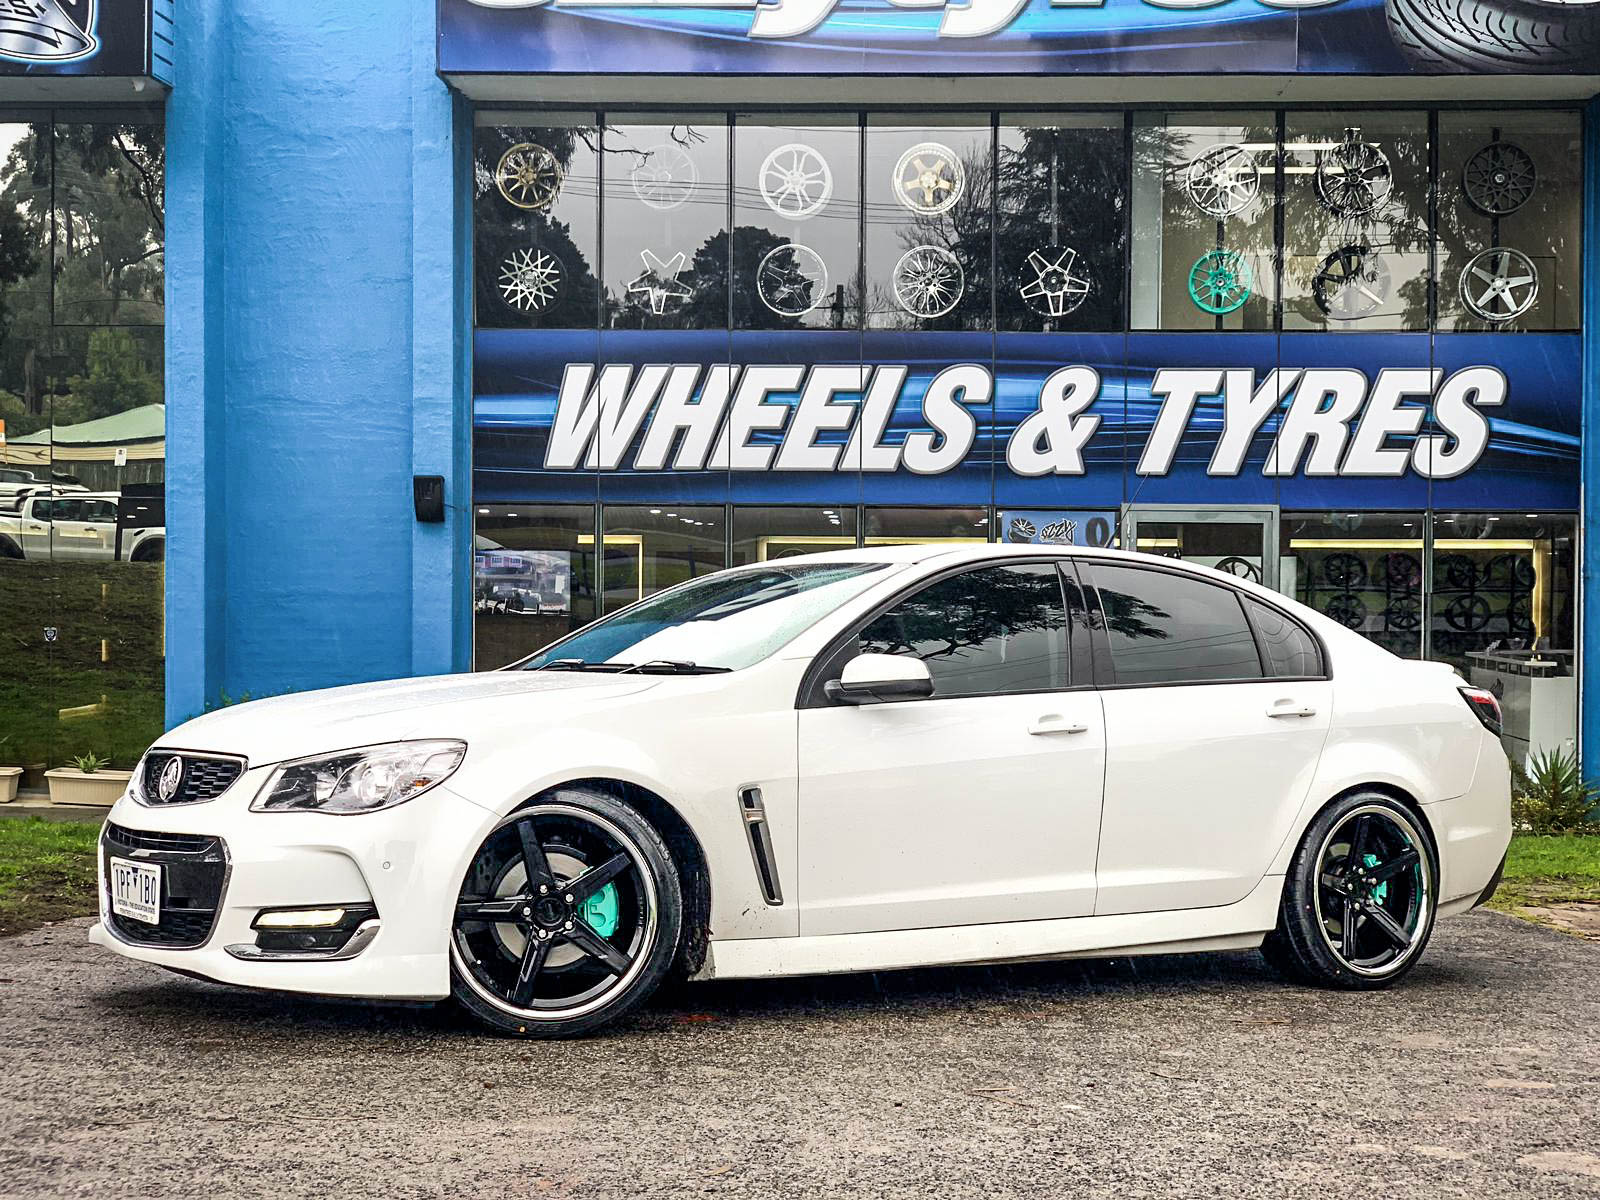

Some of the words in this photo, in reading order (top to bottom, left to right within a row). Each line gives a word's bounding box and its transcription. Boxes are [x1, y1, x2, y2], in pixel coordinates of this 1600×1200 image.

[543, 363, 993, 475] WHEELS
[1005, 365, 1101, 477] &
[1136, 365, 1507, 478] TYRES
